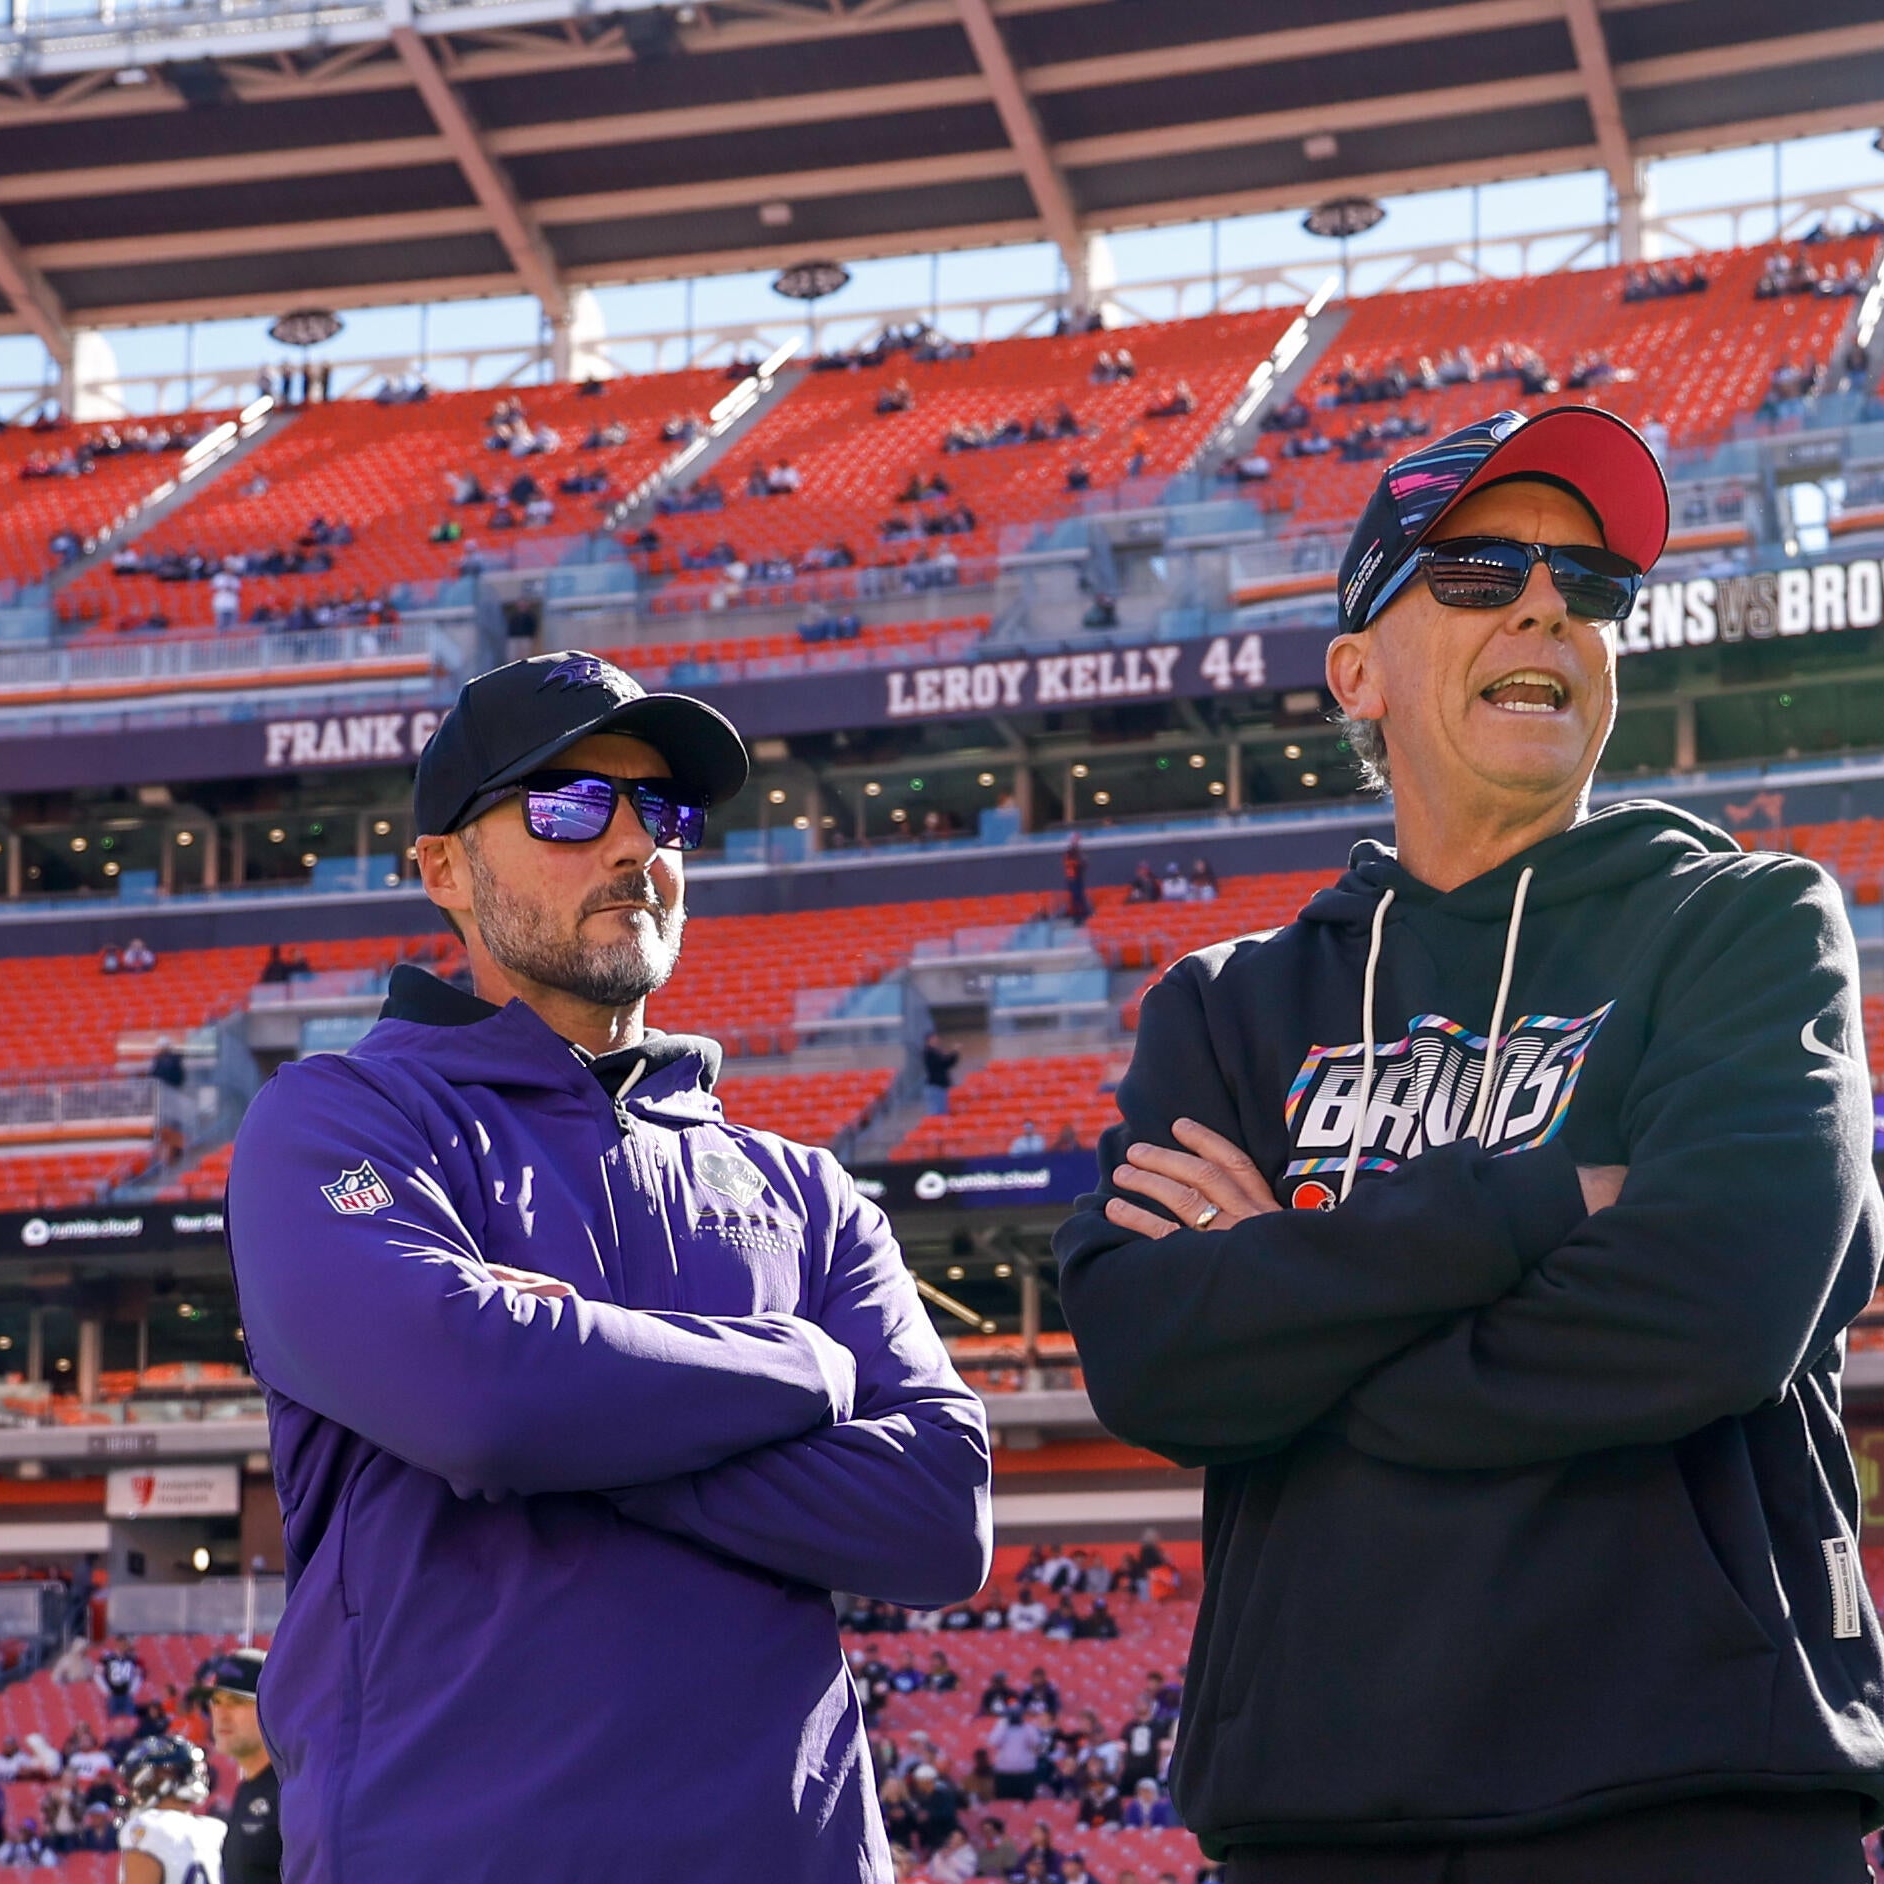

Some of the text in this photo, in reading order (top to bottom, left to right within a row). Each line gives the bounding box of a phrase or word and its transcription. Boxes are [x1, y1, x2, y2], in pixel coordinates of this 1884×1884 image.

[1616, 578, 1717, 655] ENS
[887, 634, 1266, 717] LEROY KELLY 44
[265, 713, 405, 768] FRANK
[338, 1188, 386, 1210] NFL
[947, 1168, 1051, 1193] rumble.cloud
[50, 1216, 143, 1241] rumble.cloud
